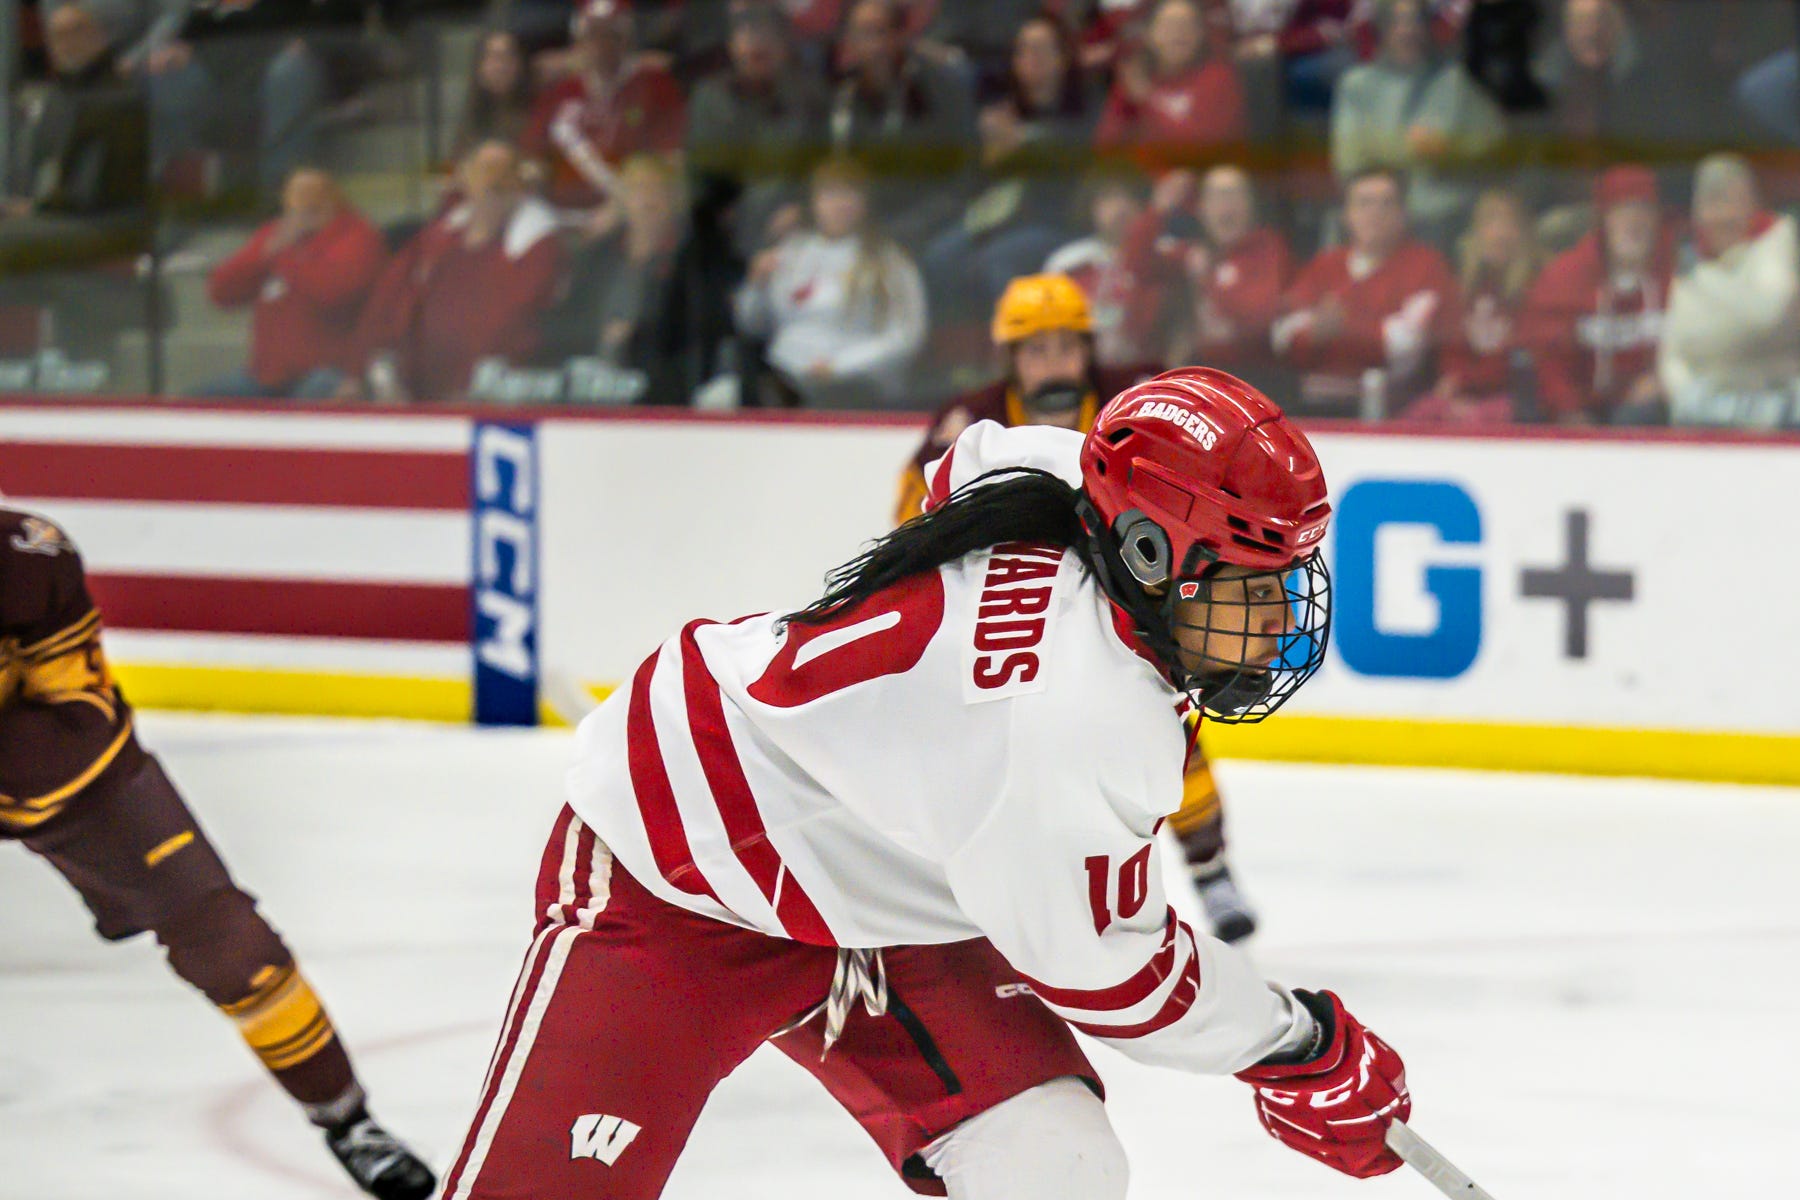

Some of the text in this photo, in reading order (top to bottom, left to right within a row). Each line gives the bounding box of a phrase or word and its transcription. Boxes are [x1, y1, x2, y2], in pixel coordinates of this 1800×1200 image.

[1136, 401, 1218, 451] BADGERS
[477, 425, 531, 677] CCM
[1084, 843, 1152, 937] 10
